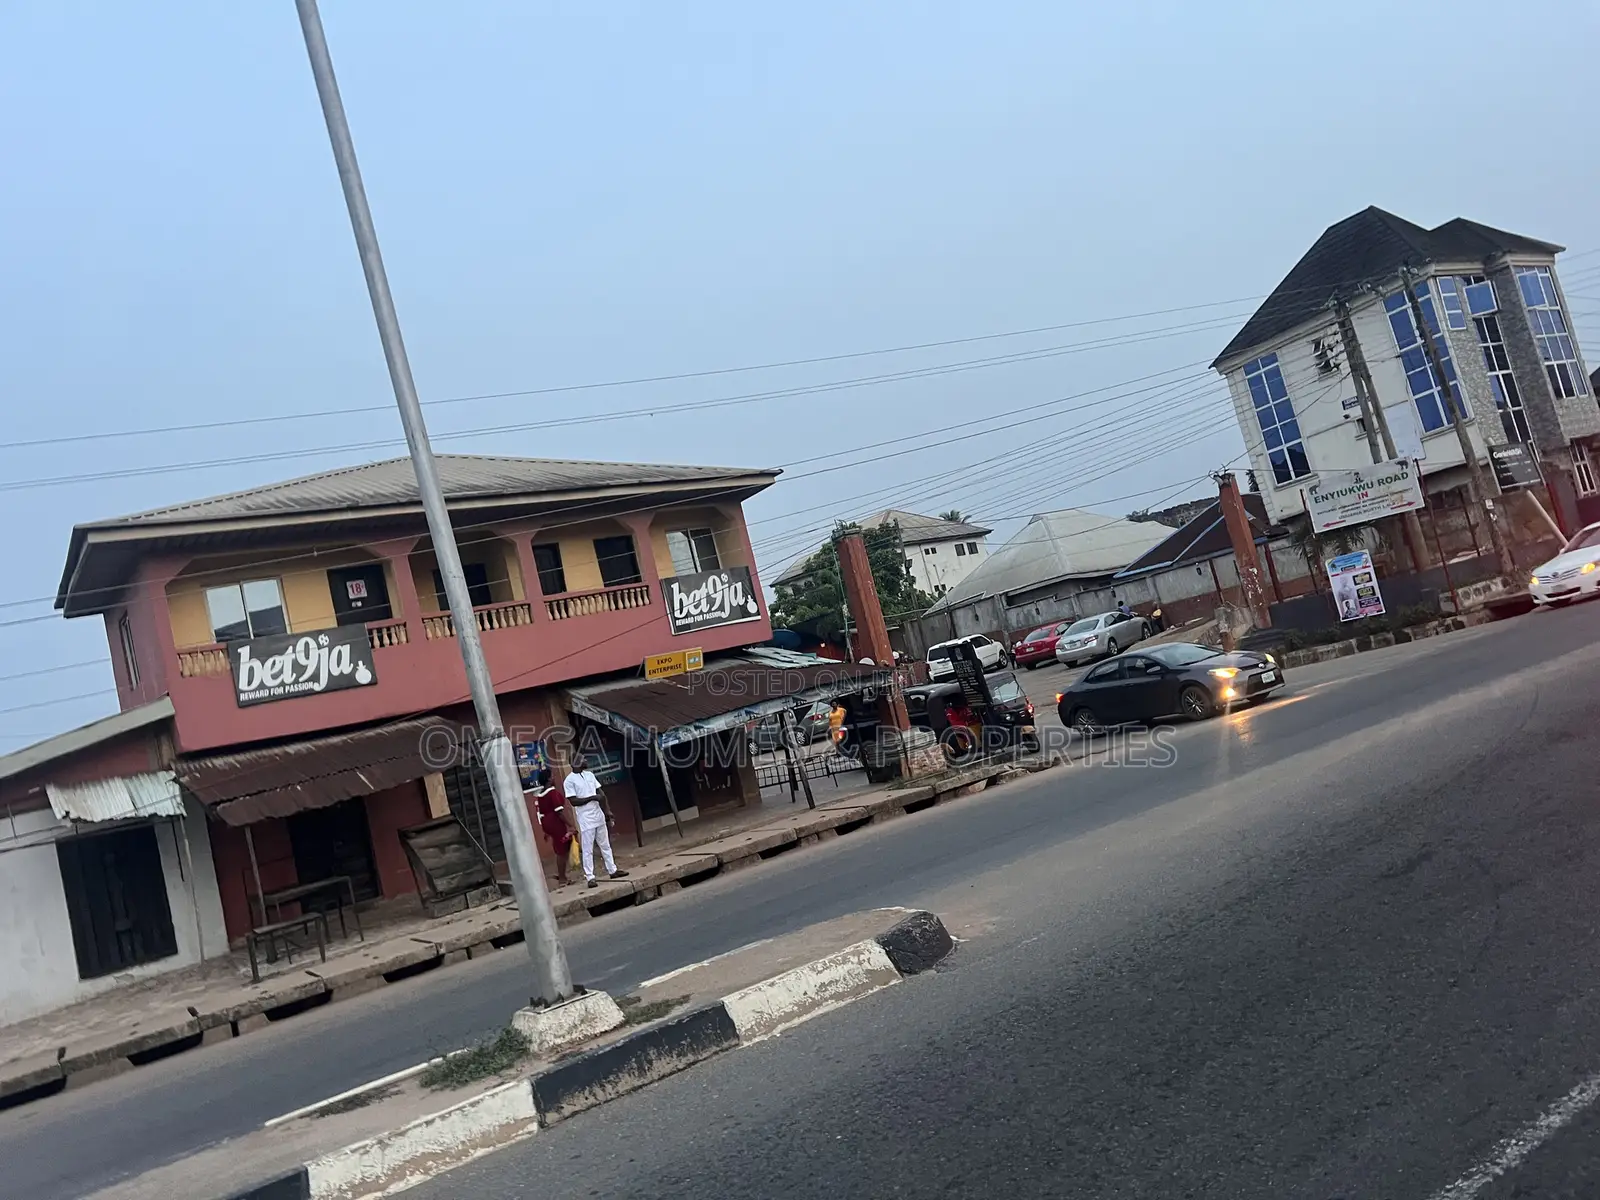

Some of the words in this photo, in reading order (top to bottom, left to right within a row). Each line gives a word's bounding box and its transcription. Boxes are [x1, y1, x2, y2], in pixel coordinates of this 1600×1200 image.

[1314, 482, 1374, 503] ENYIUKWU
[1377, 471, 1409, 487] ROAD
[1357, 491, 1369, 500] IN
[671, 573, 746, 619] bet9ja
[675, 617, 694, 627] REWARD
[694, 614, 703, 623] FOR
[237, 633, 354, 692] bet9ja
[648, 663, 682, 676] ENTERPRISE
[239, 690, 270, 702] REWARD
[270, 687, 284, 696] FOR
[285, 680, 314, 694] PASSION
